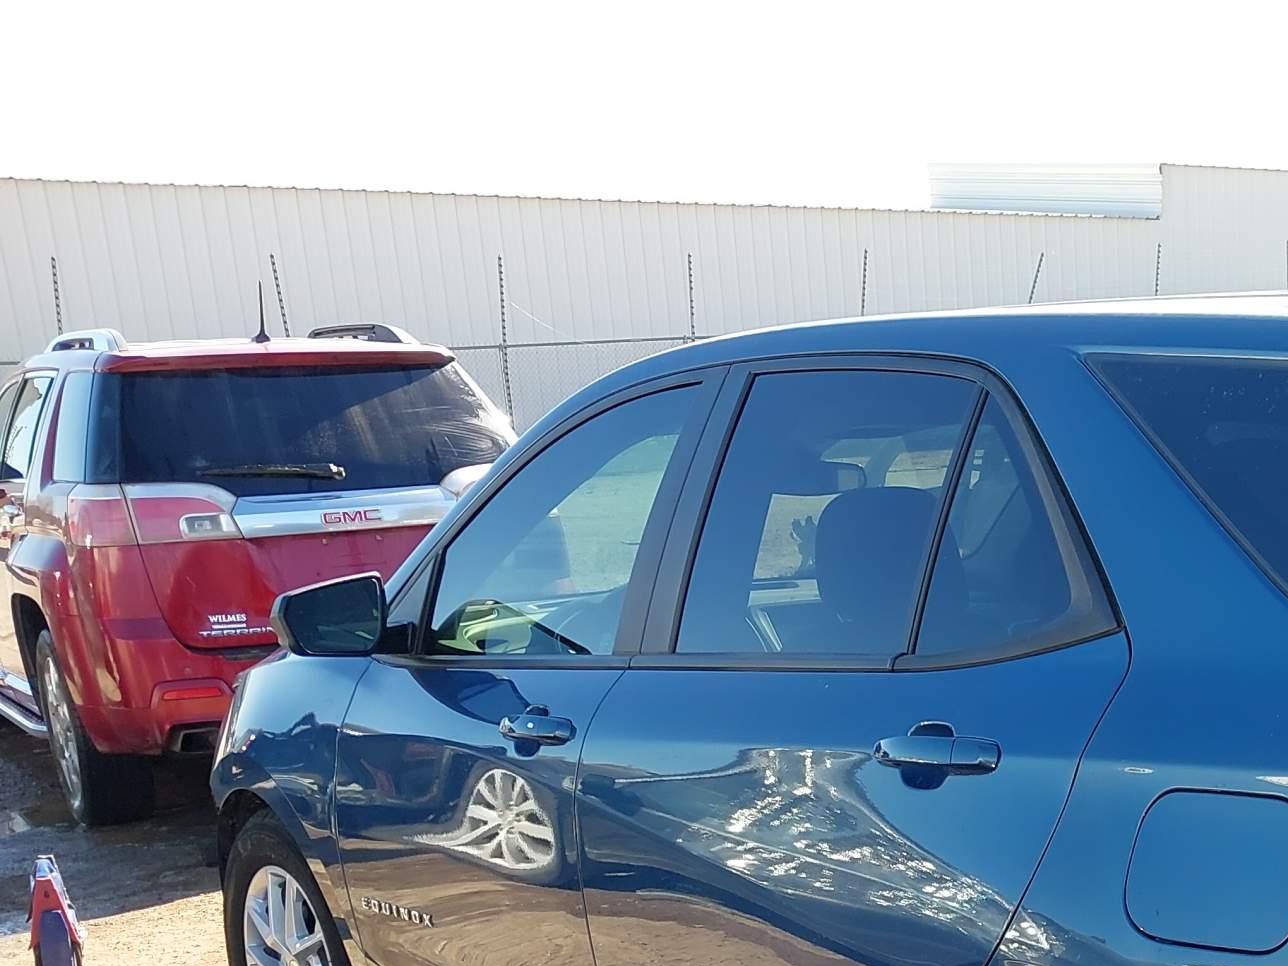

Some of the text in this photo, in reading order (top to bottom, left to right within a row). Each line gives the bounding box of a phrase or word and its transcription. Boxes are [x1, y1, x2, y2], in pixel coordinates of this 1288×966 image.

[323, 508, 382, 524] GMC
[208, 613, 247, 623] WILMES
[361, 896, 433, 929] EQUINOX
